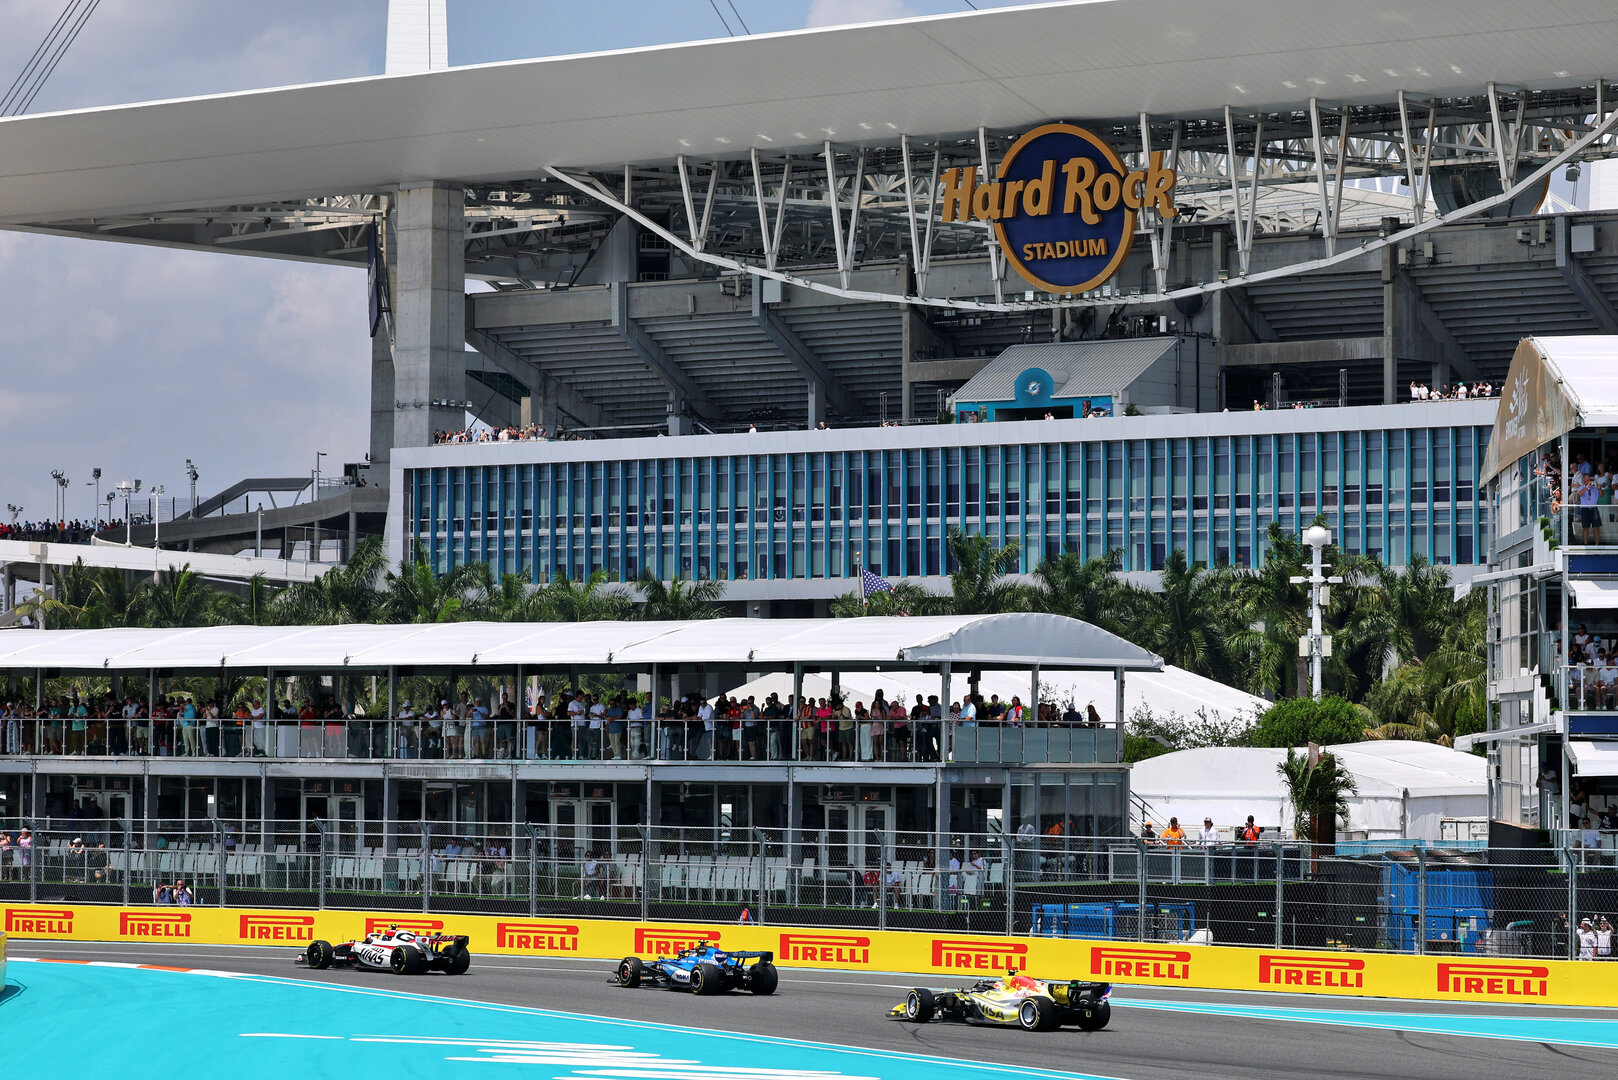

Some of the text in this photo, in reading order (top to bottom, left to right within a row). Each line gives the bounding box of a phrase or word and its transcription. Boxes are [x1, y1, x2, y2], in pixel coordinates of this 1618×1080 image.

[940, 151, 1178, 225] Hard Rock
[1023, 238, 1108, 262] STADIUM
[5, 908, 74, 934] PIRELLI
[119, 911, 192, 937] PIRELLI
[239, 914, 315, 941] PIRELLI
[496, 922, 580, 951] PIRELLI
[634, 927, 722, 956] PIRE
[780, 933, 871, 964] PIRELLI
[931, 939, 1029, 972] PIRELLI
[1090, 946, 1192, 980] PIRELLI
[1258, 954, 1366, 988] PIRELLI
[1436, 962, 1550, 997] PIRELLI
[978, 1002, 1005, 1020] VISA
